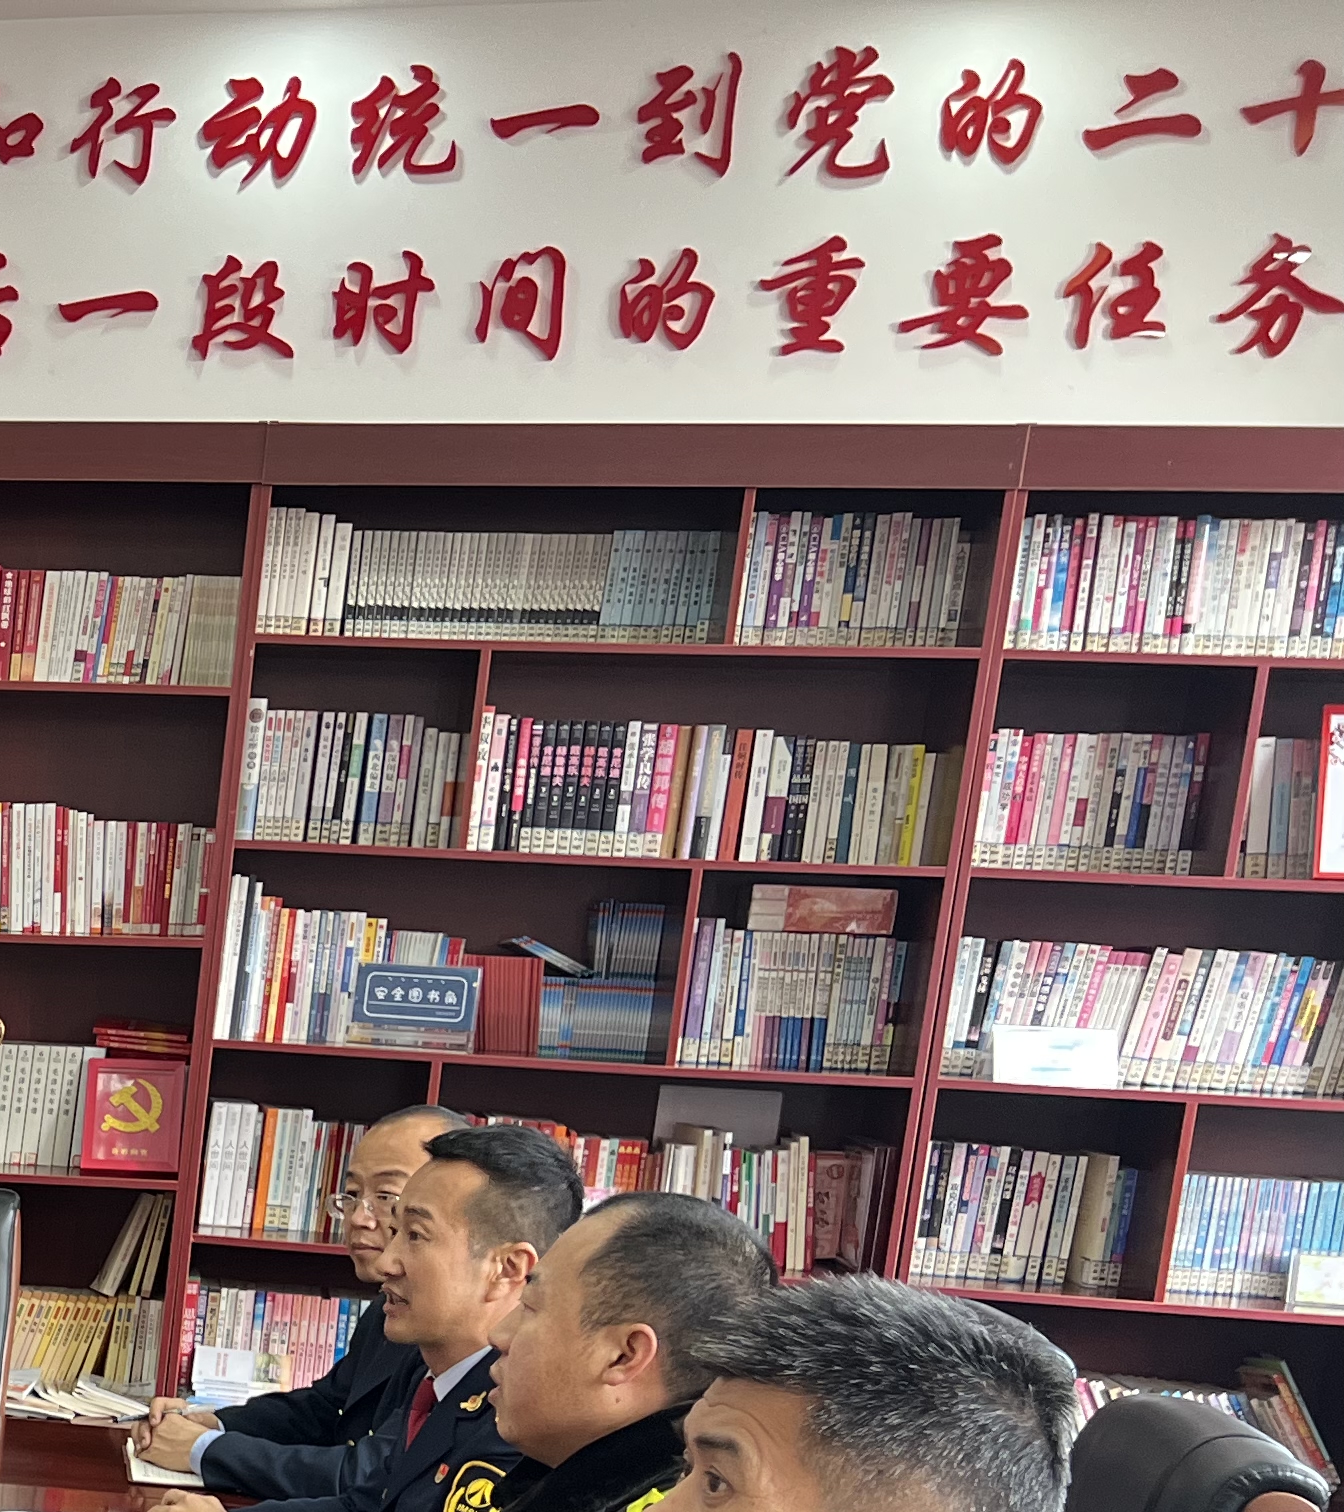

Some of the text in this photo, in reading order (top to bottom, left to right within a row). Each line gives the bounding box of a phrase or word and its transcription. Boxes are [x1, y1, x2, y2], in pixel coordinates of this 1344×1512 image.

[374, 985, 458, 1007] 安全图书角
